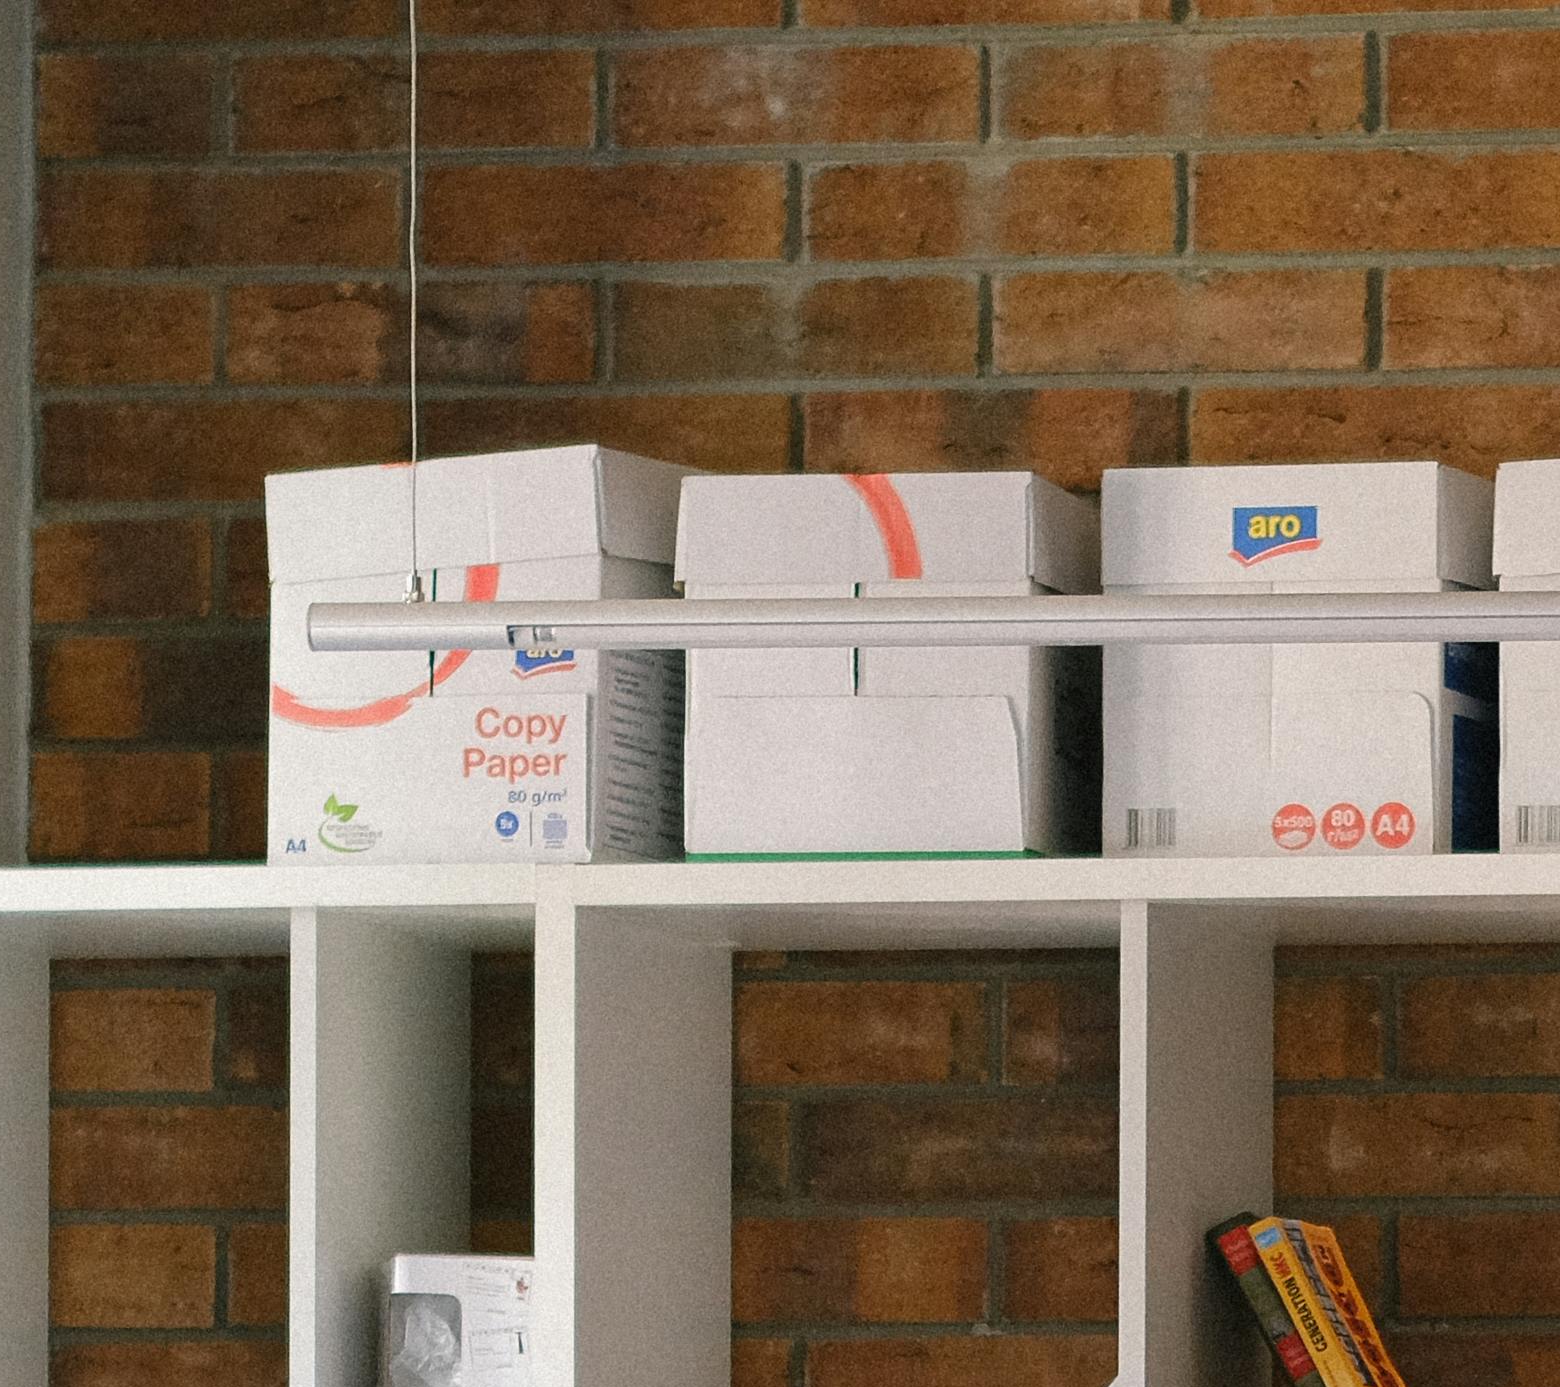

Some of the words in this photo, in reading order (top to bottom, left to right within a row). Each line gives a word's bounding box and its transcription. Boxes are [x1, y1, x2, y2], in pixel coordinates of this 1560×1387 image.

[1248, 511, 1301, 541] aro
[474, 706, 567, 744] Copy
[462, 747, 567, 784] Paper
[507, 790, 527, 804] 80
[1274, 815, 1313, 828] 5x500
[1330, 809, 1356, 827] 80
[1375, 814, 1410, 836] A4
[1283, 1275, 1328, 1354] GENERATION
